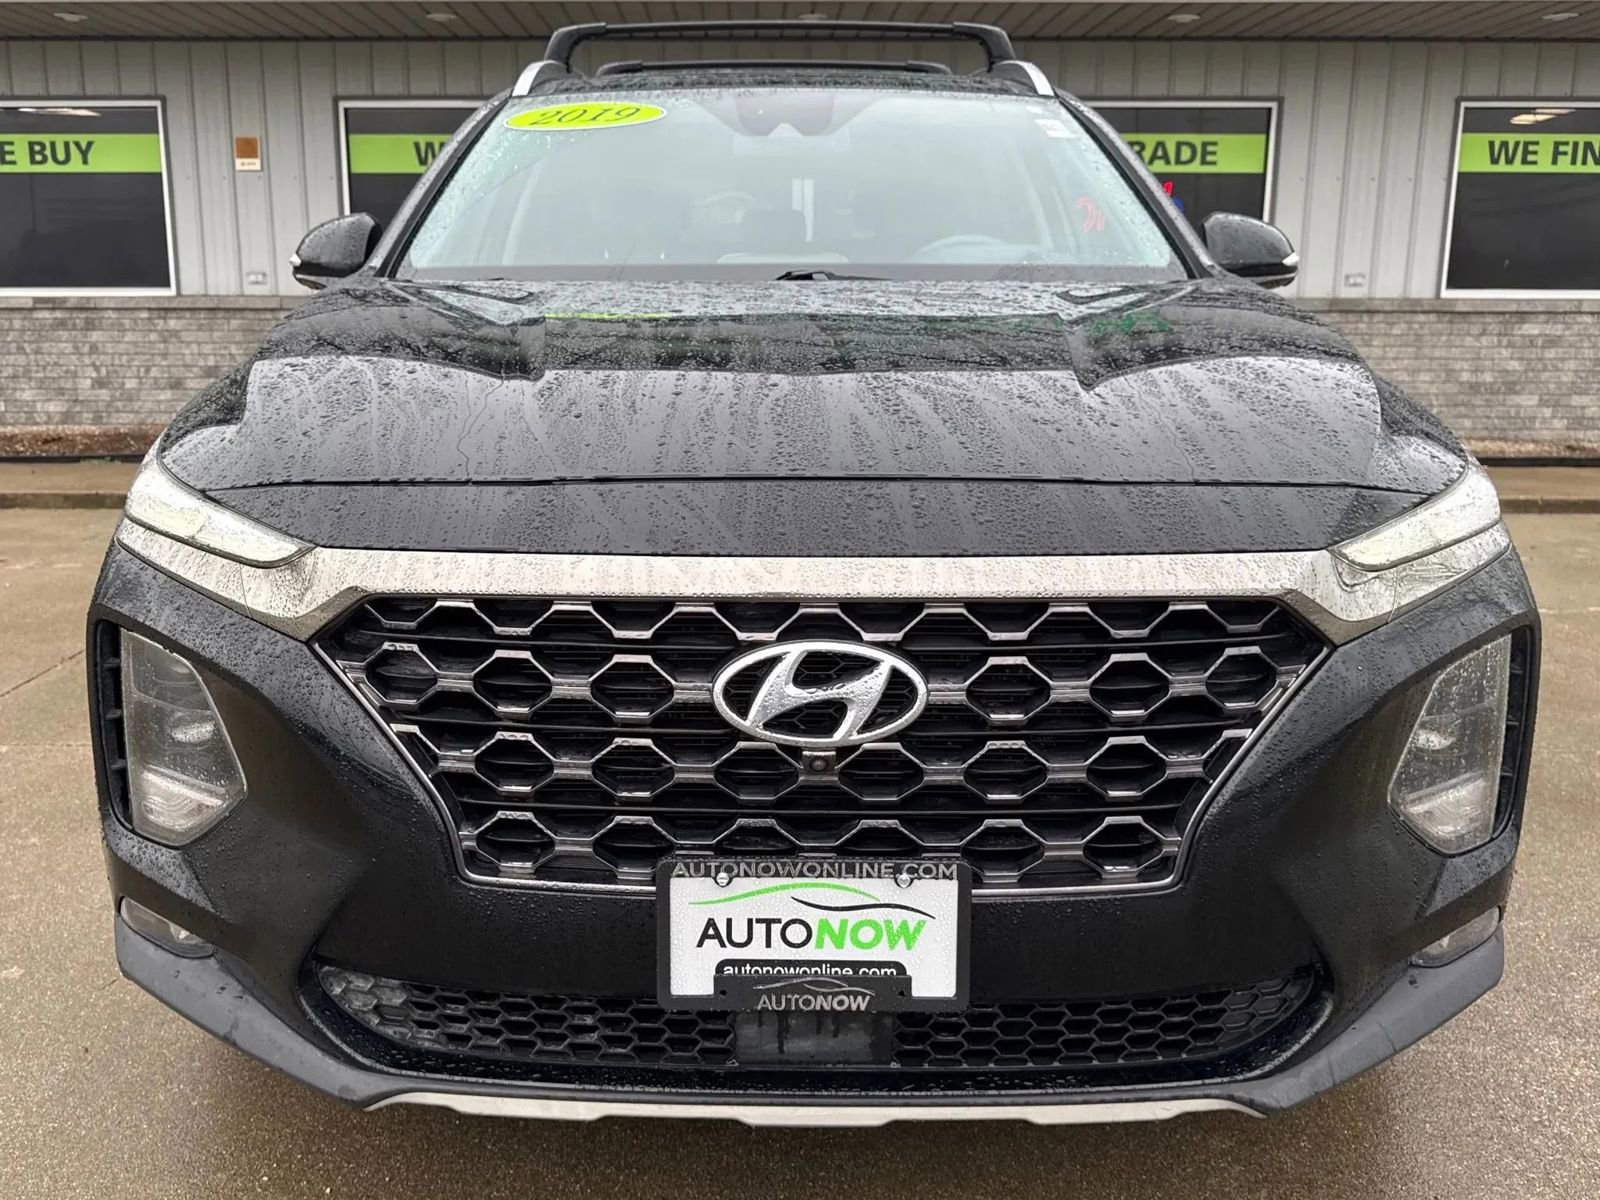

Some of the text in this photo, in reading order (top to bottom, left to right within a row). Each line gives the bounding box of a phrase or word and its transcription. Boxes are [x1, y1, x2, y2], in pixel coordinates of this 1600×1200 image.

[528, 106, 641, 126] 2019
[27, 140, 95, 166] BUY
[1487, 140, 1600, 166] WE FIN
[671, 861, 958, 880] AUTONOWONLINE.COM
[723, 963, 897, 976] autonowonlinecom
